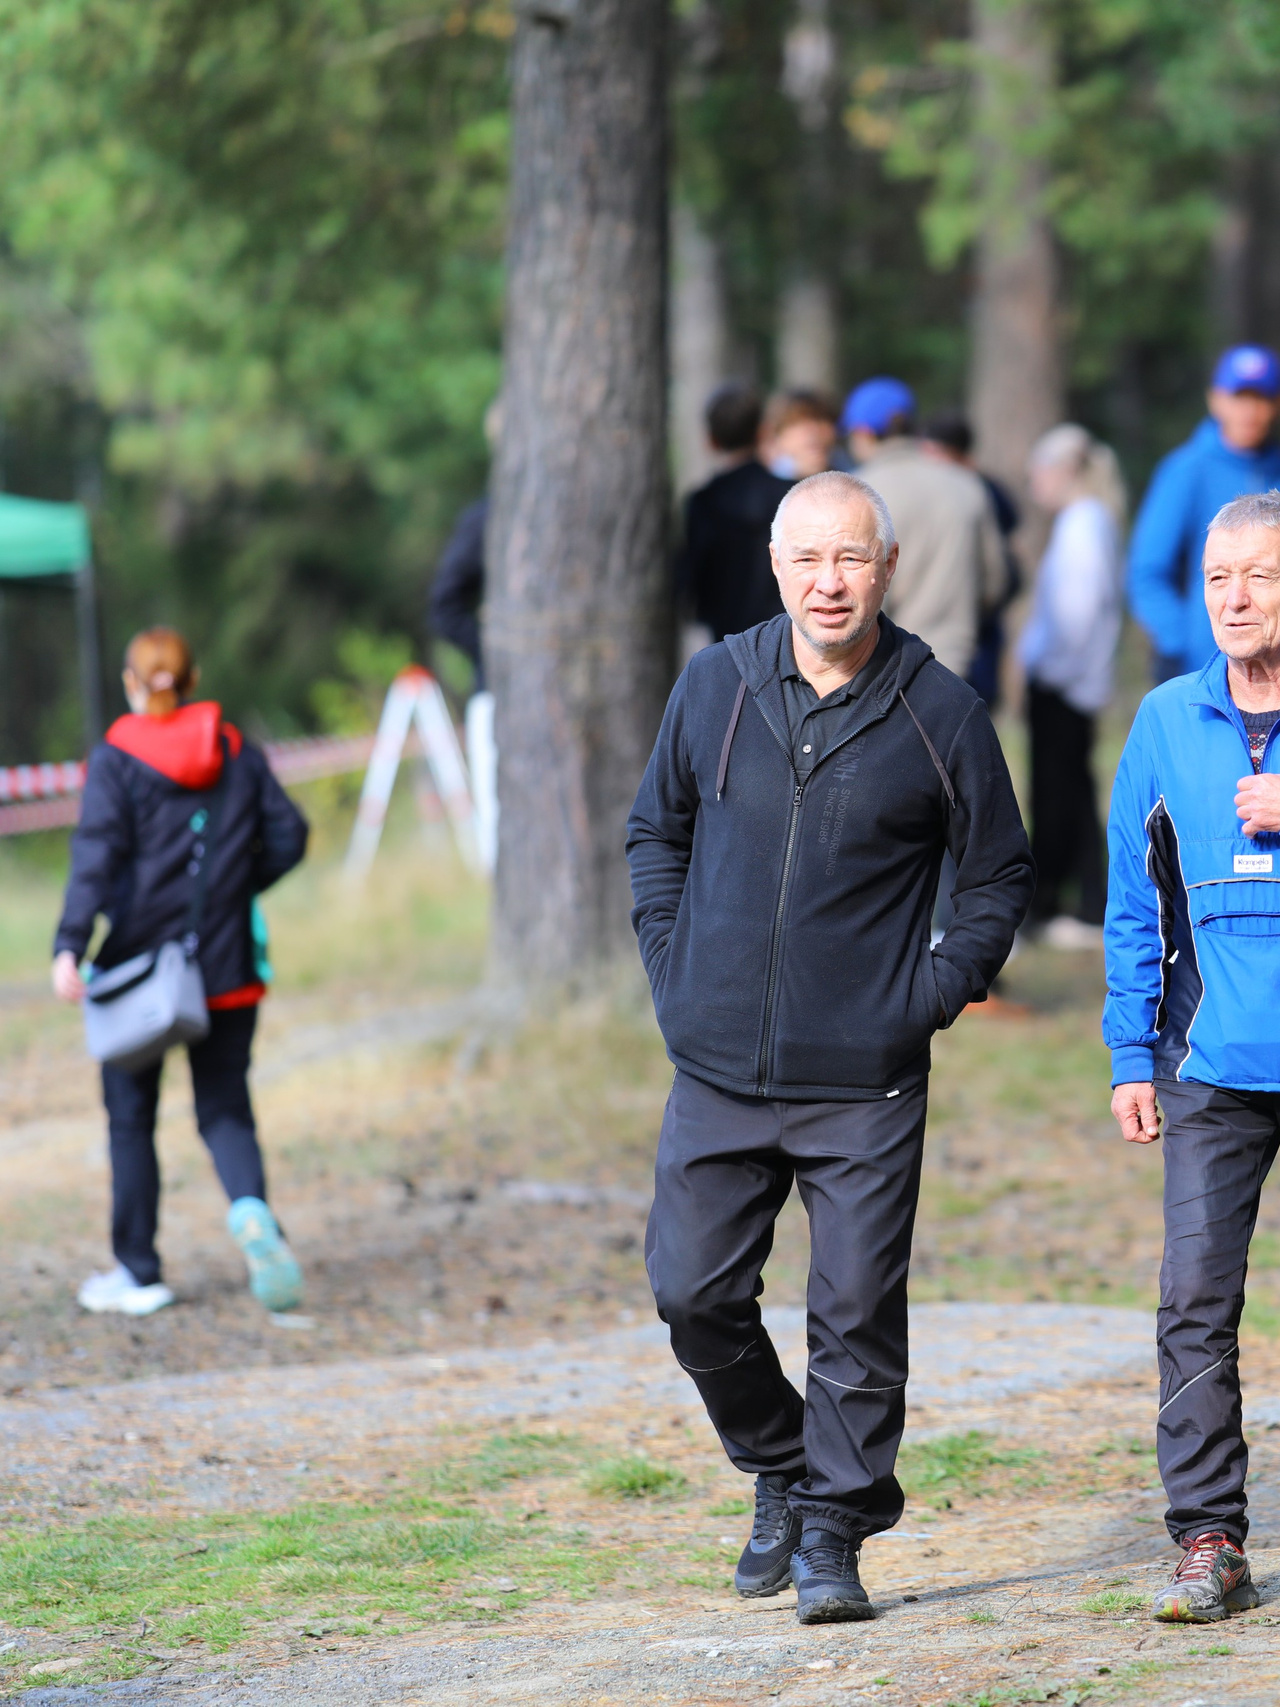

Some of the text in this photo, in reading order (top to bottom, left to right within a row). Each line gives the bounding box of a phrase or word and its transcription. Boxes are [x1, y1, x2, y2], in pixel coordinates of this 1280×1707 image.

[818, 787, 837, 844] SINCE 1989
[825, 788, 850, 876] SNOWBOARDING
